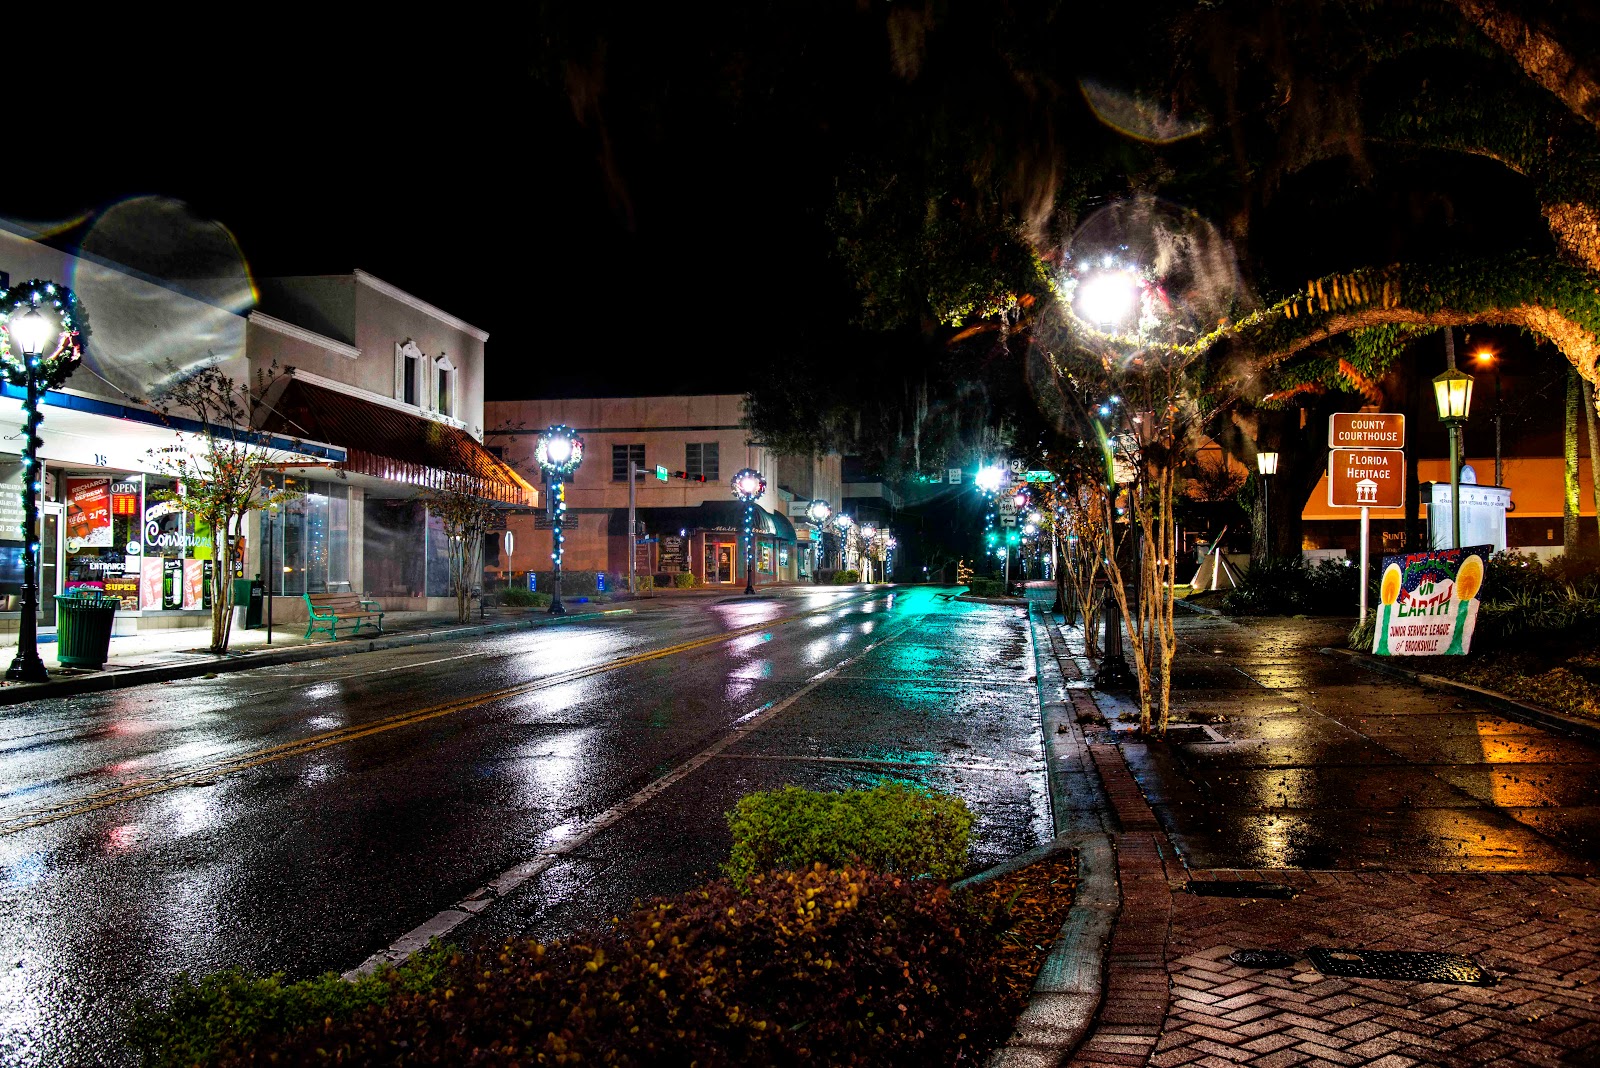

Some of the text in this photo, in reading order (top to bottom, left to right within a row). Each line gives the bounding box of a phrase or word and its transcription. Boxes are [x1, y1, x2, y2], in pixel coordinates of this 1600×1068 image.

[1351, 420, 1385, 429] COUNTY
[1338, 431, 1398, 441] COURTHOUSE
[1349, 453, 1388, 465] FLORIDA
[1347, 467, 1391, 479] HERITAGE
[72, 479, 108, 493] RECHARGE
[111, 483, 137, 493] OPEN
[75, 489, 103, 501] REFRESH
[146, 500, 182, 522] CORNE
[89, 562, 126, 570] ENTRANCE
[1403, 549, 1460, 585] PEACE
[1419, 573, 1437, 596] ON
[1398, 583, 1453, 617] EARTH
[1390, 624, 1451, 637] JUNIOR SERVICE LEAGUE
[1405, 640, 1438, 652] BROOKSVILLE
